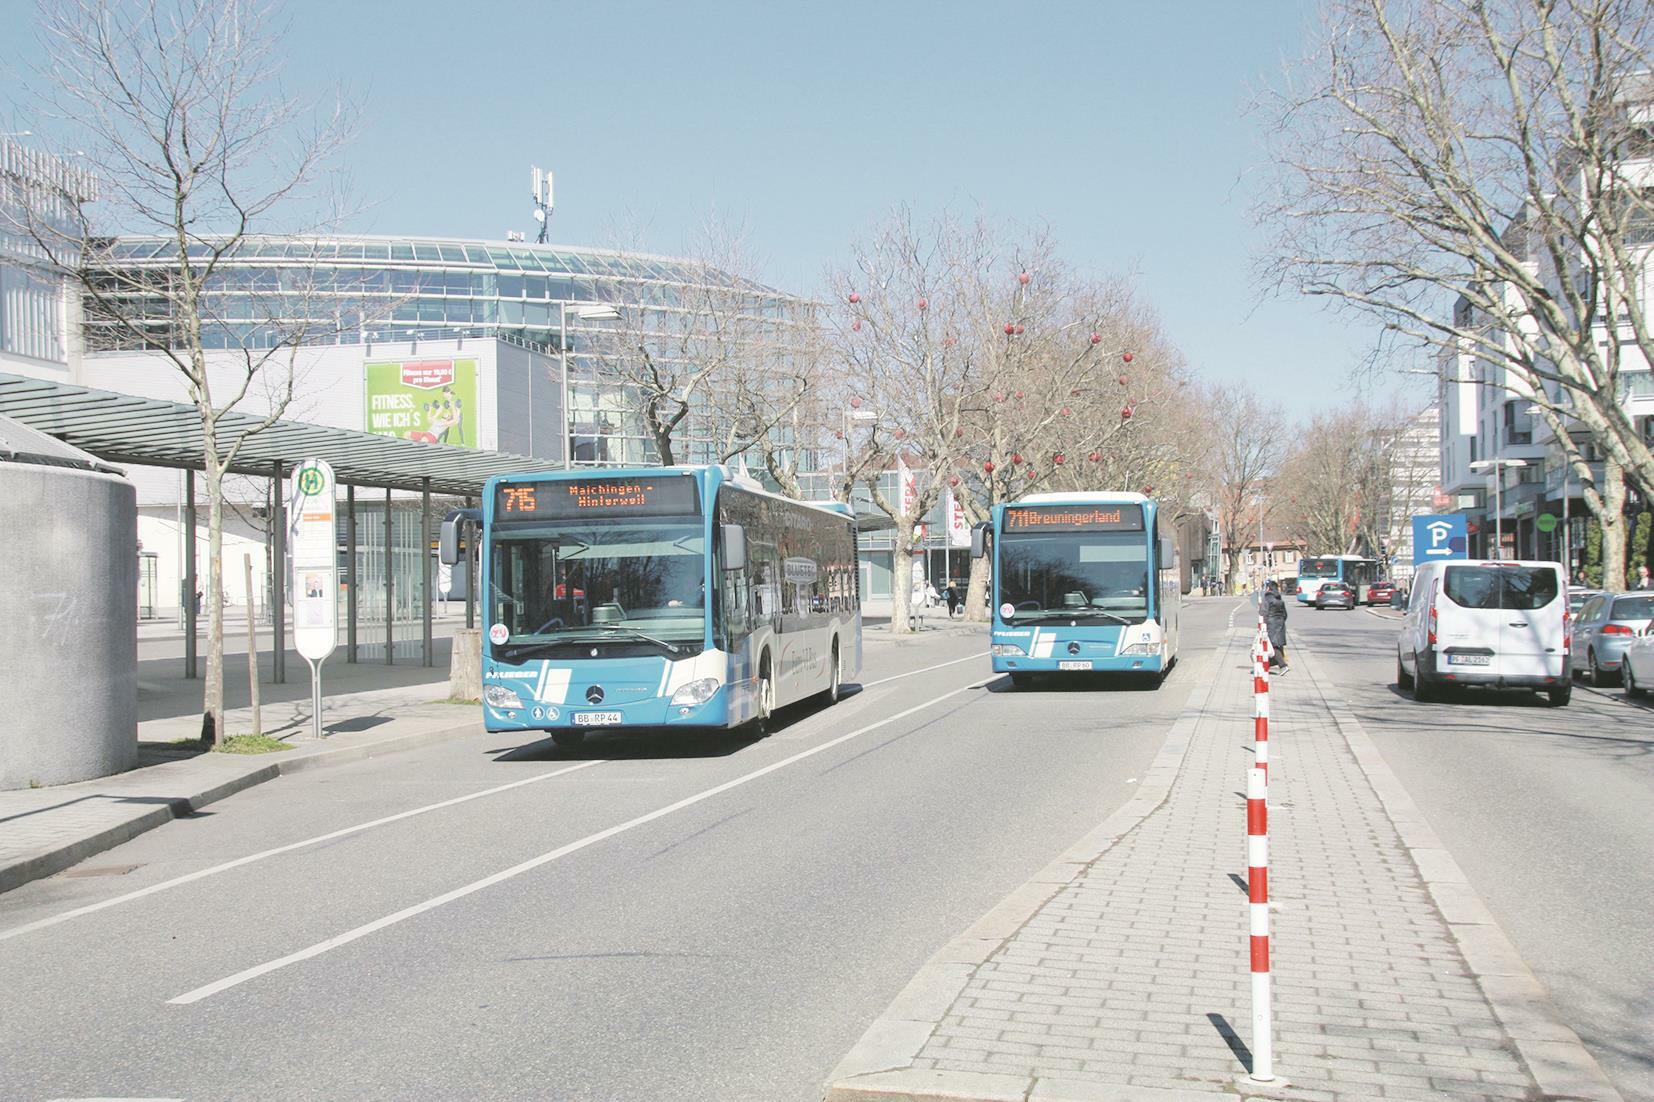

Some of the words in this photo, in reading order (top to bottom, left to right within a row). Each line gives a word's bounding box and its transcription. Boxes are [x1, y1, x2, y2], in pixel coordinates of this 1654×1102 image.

[371, 412, 392, 428] WIE
[569, 485, 641, 496] Maichingen
[578, 494, 645, 507] Hinterweil
[1008, 510, 1029, 528] 711
[1029, 509, 1120, 526] Breuningerland
[1432, 528, 1447, 547] P
[577, 713, 589, 723] BB
[593, 713, 605, 723] RP
[607, 713, 618, 722] 44
